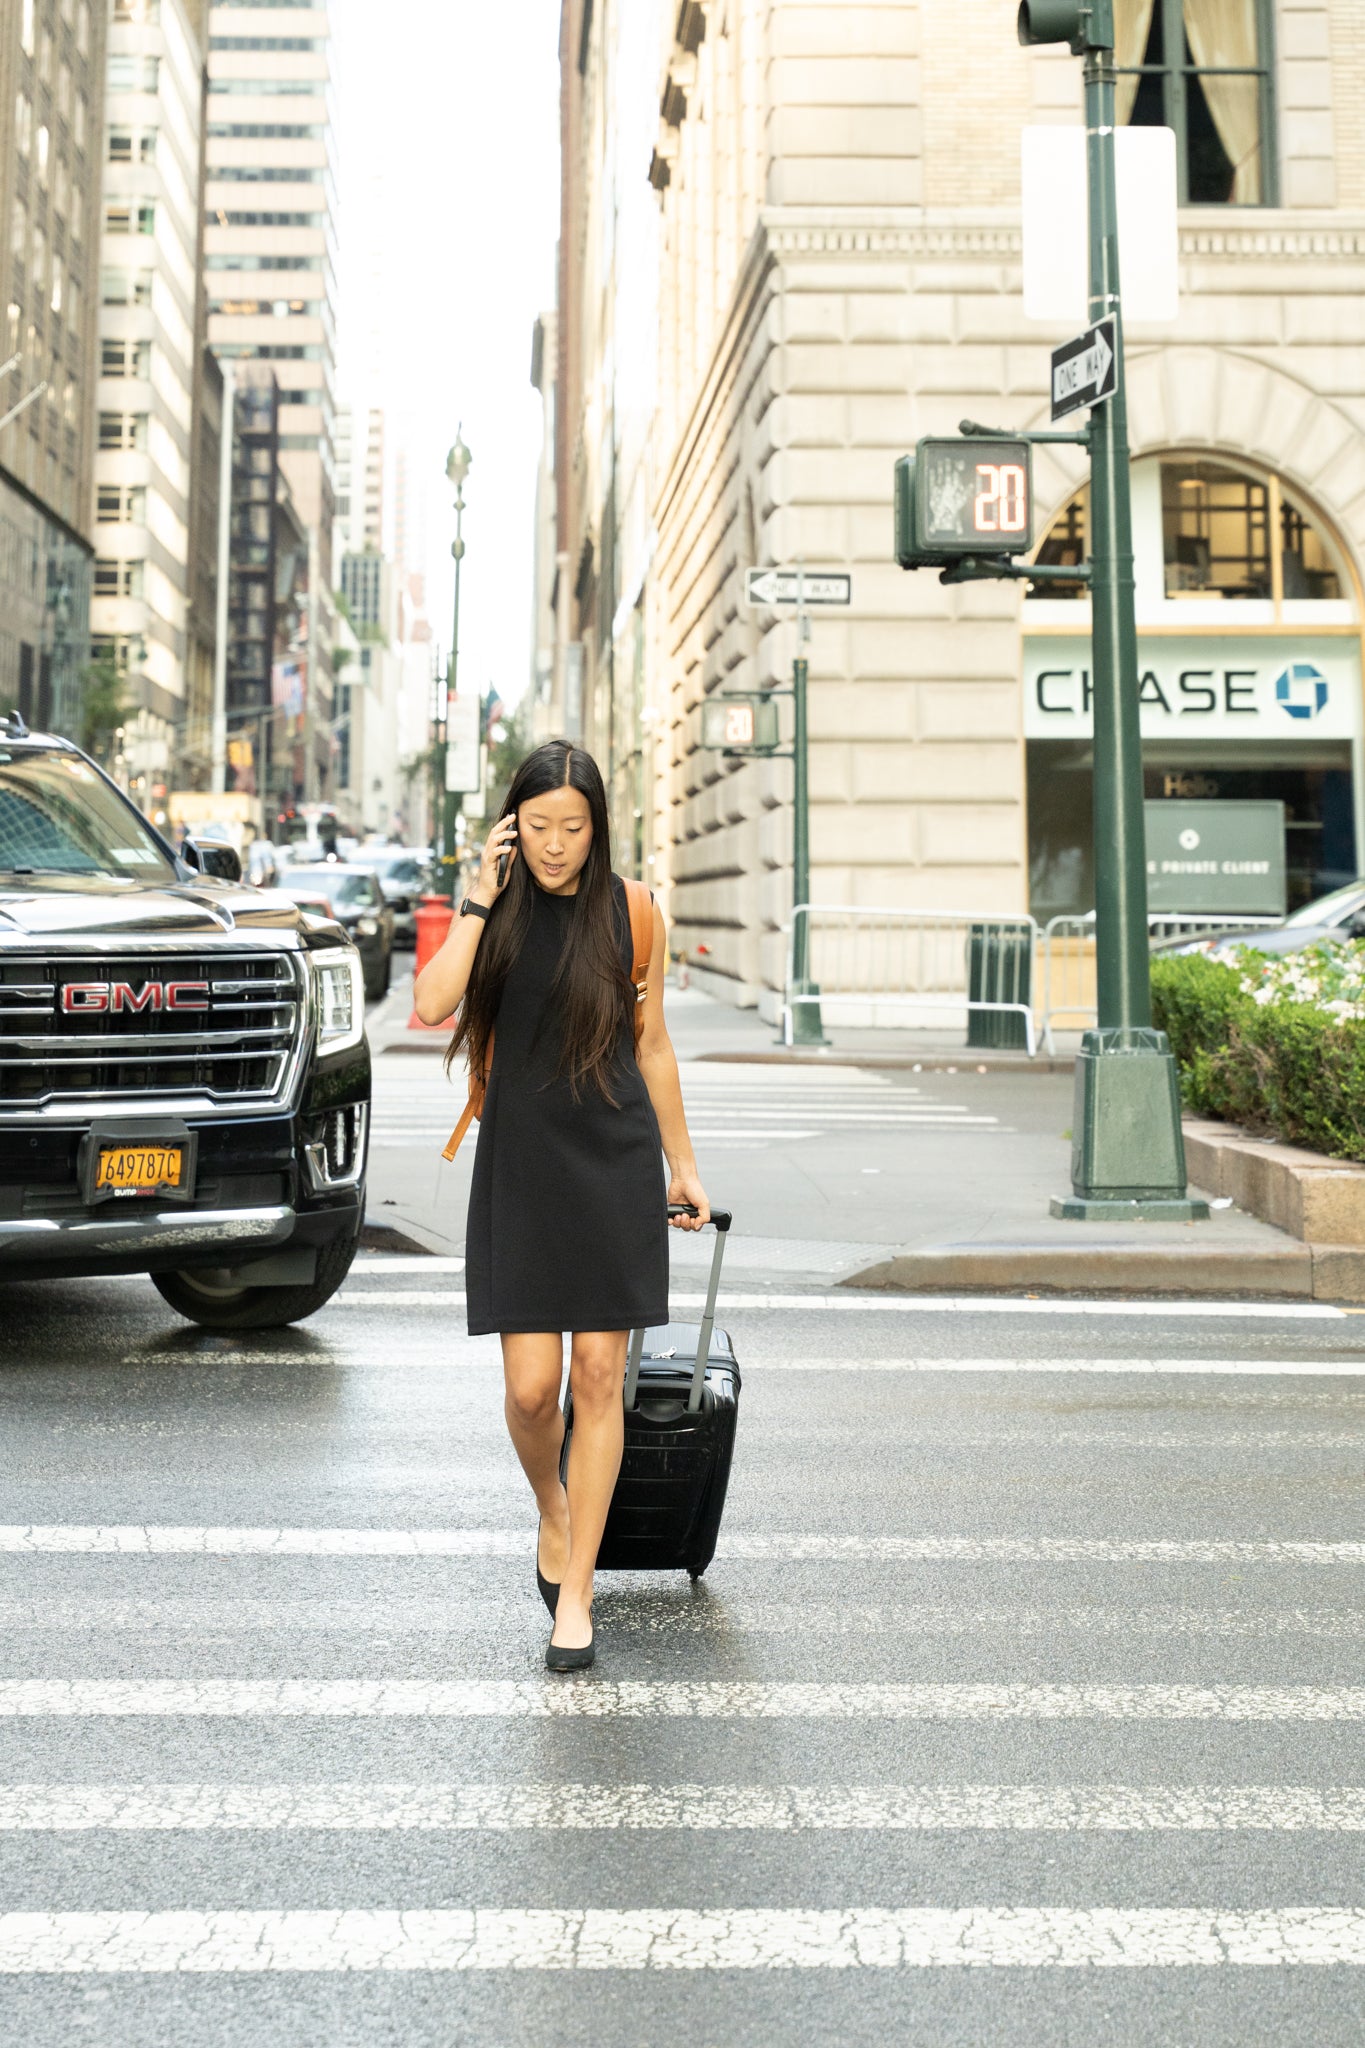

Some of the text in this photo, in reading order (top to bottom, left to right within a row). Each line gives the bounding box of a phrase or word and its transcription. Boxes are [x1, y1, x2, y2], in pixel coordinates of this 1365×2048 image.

[1059, 343, 1107, 395] ONE WAY
[974, 463, 1026, 531] 20
[811, 583, 841, 594] WAY
[726, 707, 754, 742] 20
[1161, 860, 1218, 875] PRIVATE
[1222, 860, 1270, 875] CLIENT
[61, 981, 209, 1014] GMC
[97, 1152, 176, 1181] T649787C
